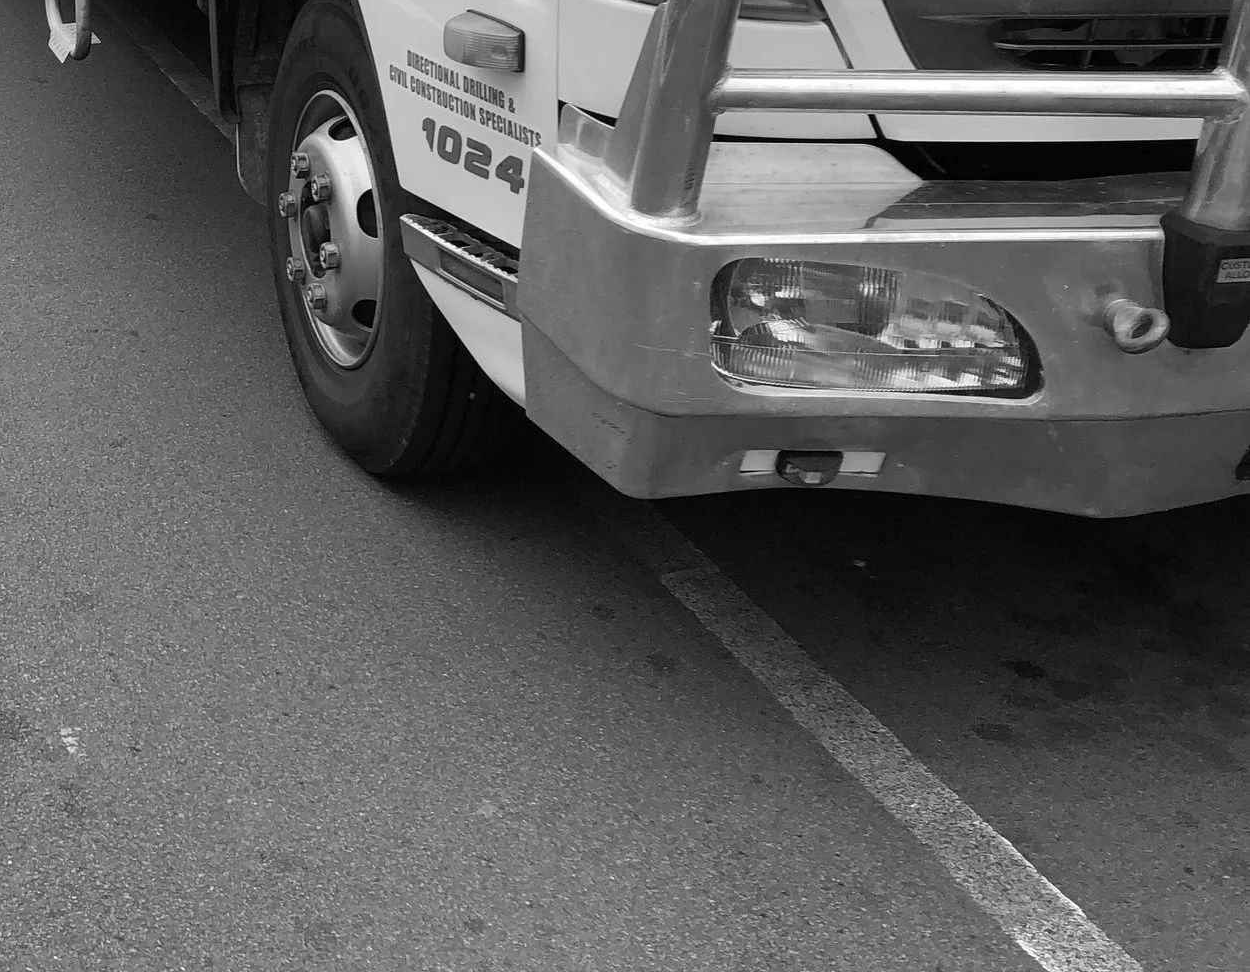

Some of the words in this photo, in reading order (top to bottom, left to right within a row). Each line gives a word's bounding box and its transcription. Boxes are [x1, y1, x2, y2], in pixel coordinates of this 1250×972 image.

[389, 64, 409, 89] CIVIL
[410, 75, 477, 121] CONSTRUCTION
[478, 107, 542, 147] SPECIALISTS
[407, 49, 461, 90] DIRECTIONAL
[463, 75, 505, 110] DRILLING
[508, 97, 516, 114] &
[421, 117, 525, 195] 1024
[1221, 261, 1250, 270] CUST
